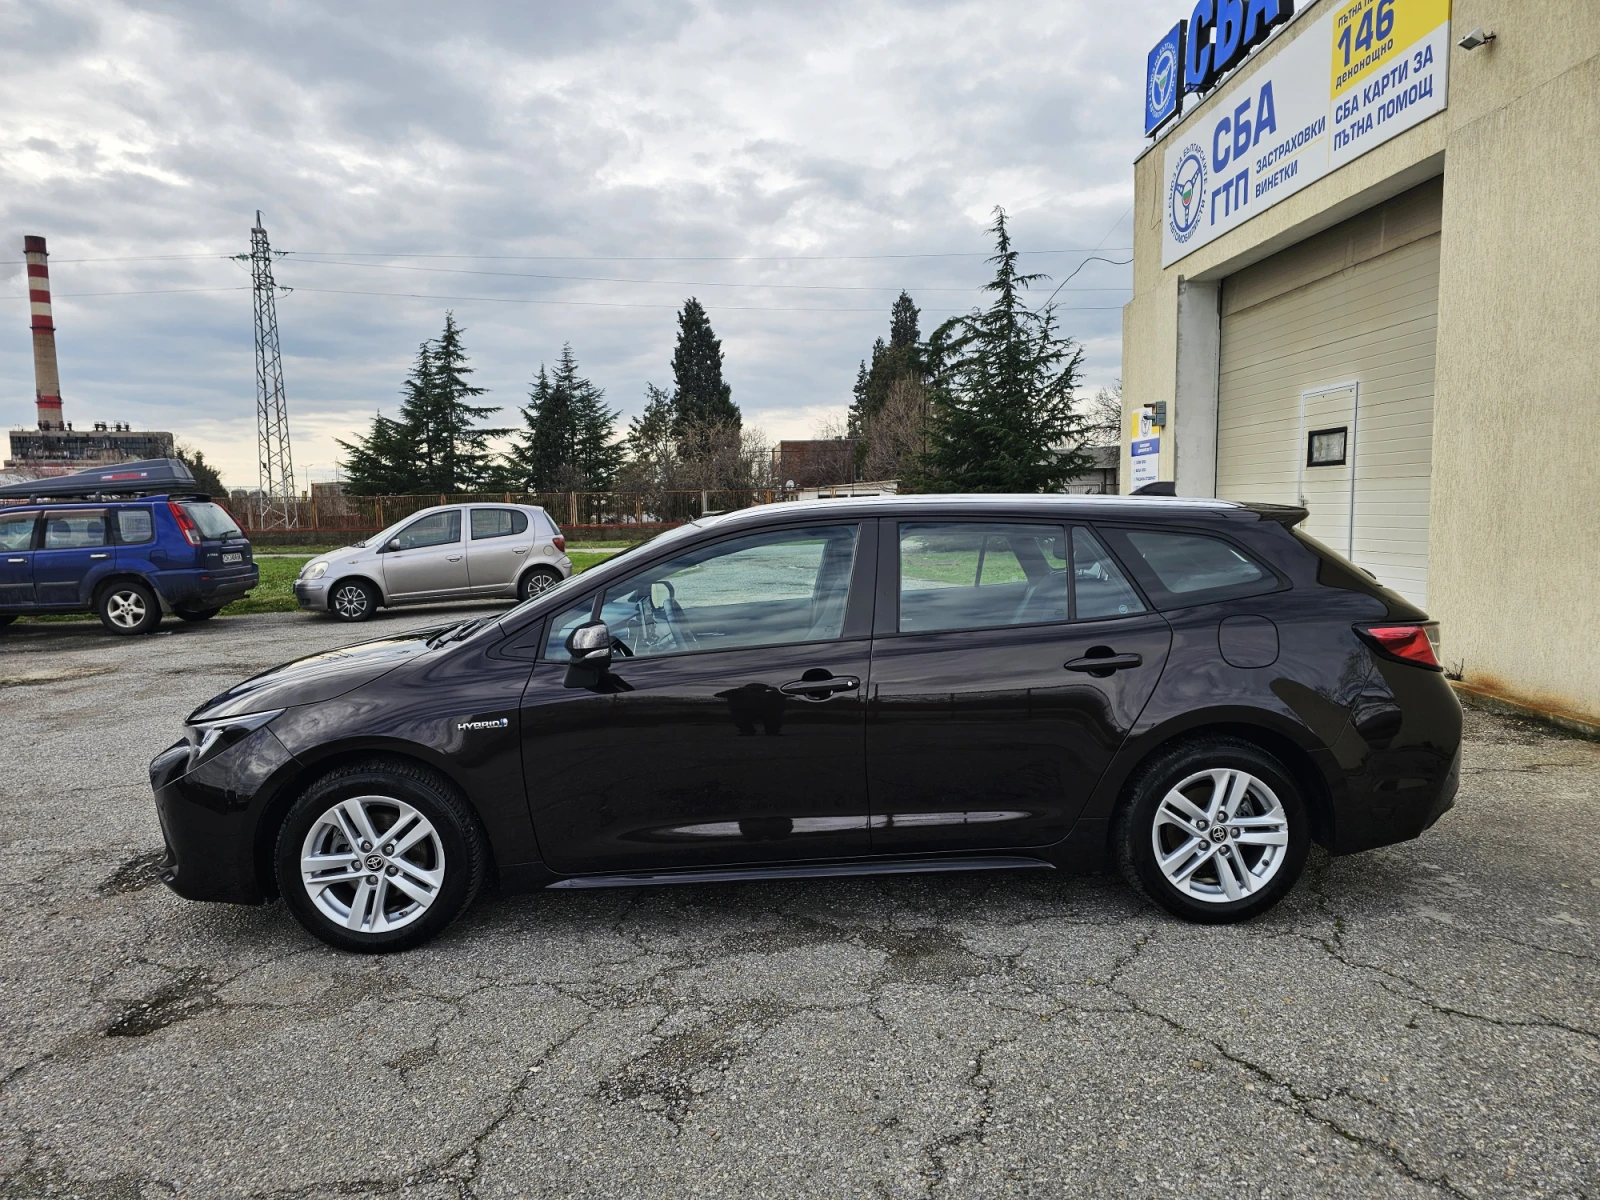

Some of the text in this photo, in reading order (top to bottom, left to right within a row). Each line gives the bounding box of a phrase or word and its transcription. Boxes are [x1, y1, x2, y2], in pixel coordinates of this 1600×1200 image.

[1337, 0, 1395, 67] 146
[1338, 1, 1362, 28] ПЪТНА
[1334, 73, 1433, 152] ПЪТНА ПОМОЩ
[1335, 44, 1434, 125] СБА КАРТИ ЗА
[1212, 79, 1277, 174] СБА
[1256, 115, 1326, 174] ЗАСТРАХОВКИ
[1210, 167, 1249, 226] ГТП
[1255, 159, 1298, 198] ВИНЕТКИ
[457, 720, 500, 731] HYBRID
